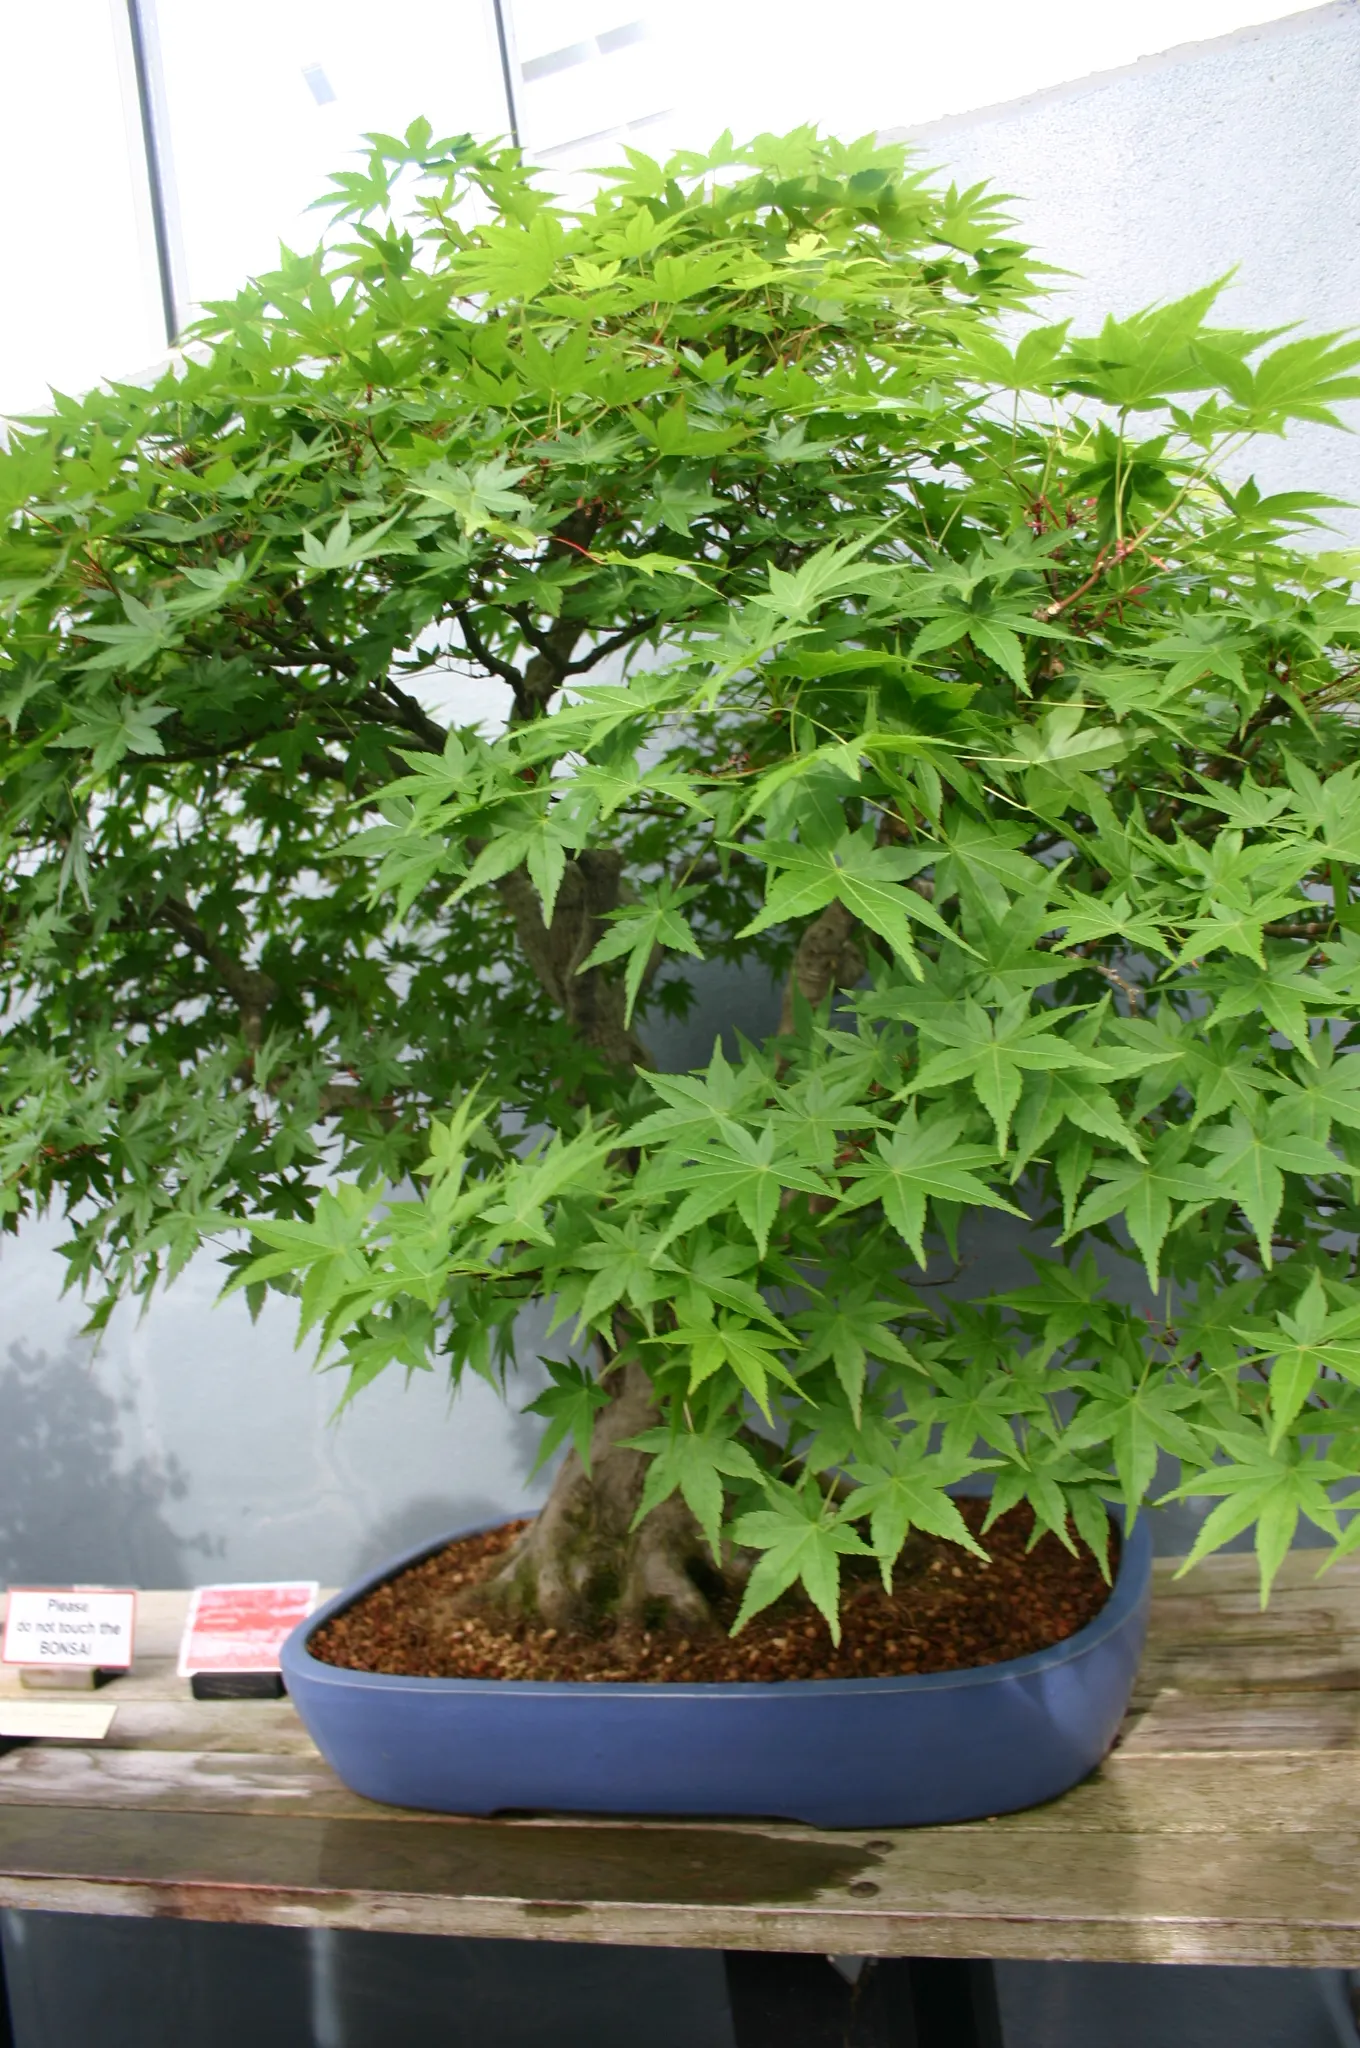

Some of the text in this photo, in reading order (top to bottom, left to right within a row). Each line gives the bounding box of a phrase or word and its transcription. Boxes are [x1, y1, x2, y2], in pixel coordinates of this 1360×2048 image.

[16, 1621, 121, 1635] do not touch the
[40, 1641, 91, 1655] BONSAI
